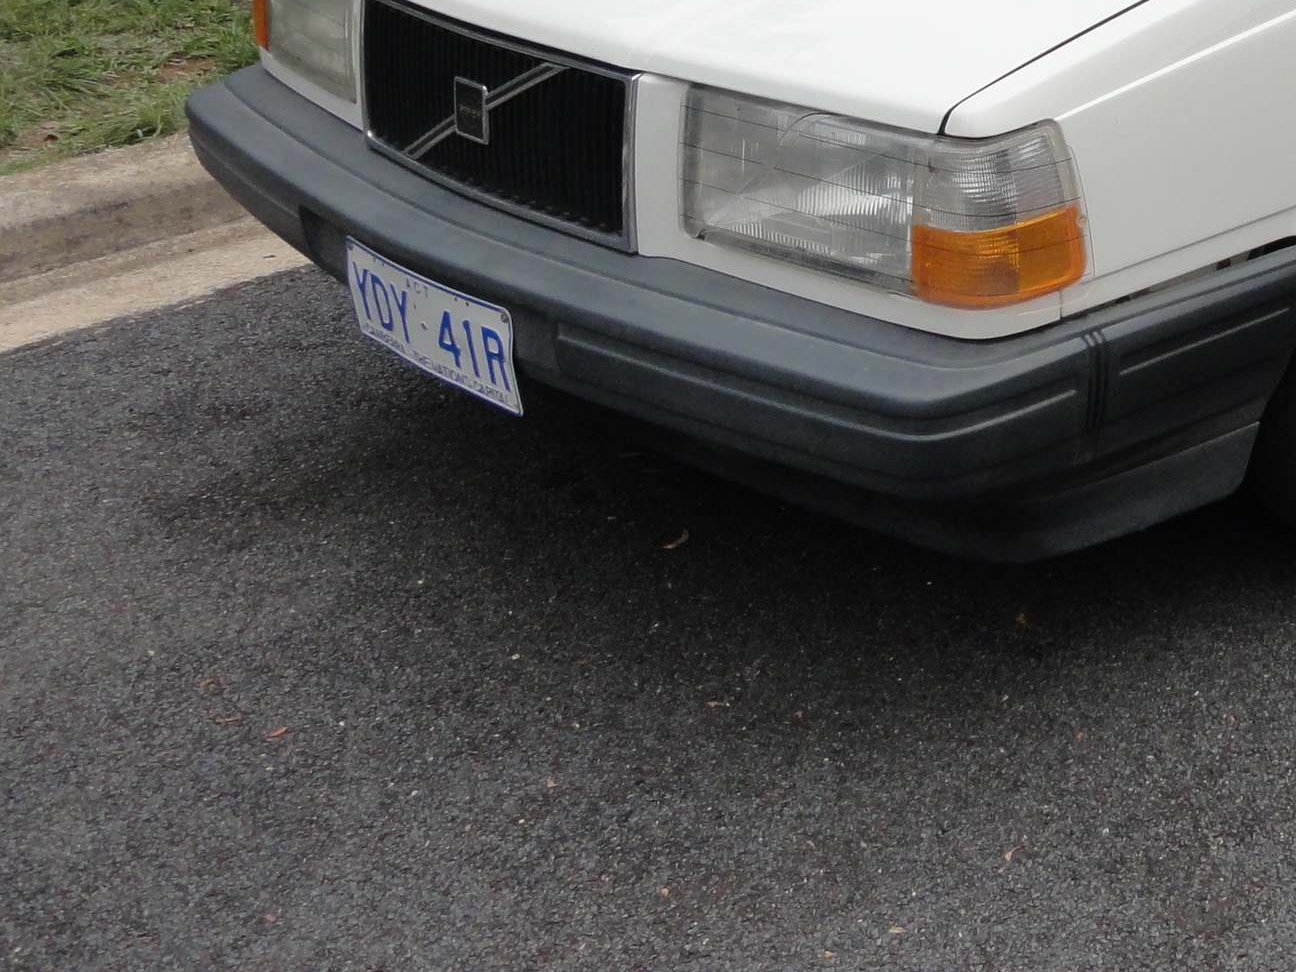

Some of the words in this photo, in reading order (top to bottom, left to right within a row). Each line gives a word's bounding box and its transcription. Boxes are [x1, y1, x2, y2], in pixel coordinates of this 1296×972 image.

[405, 278, 429, 298] ACT
[352, 261, 411, 344] YDY
[438, 310, 511, 393] 41R
